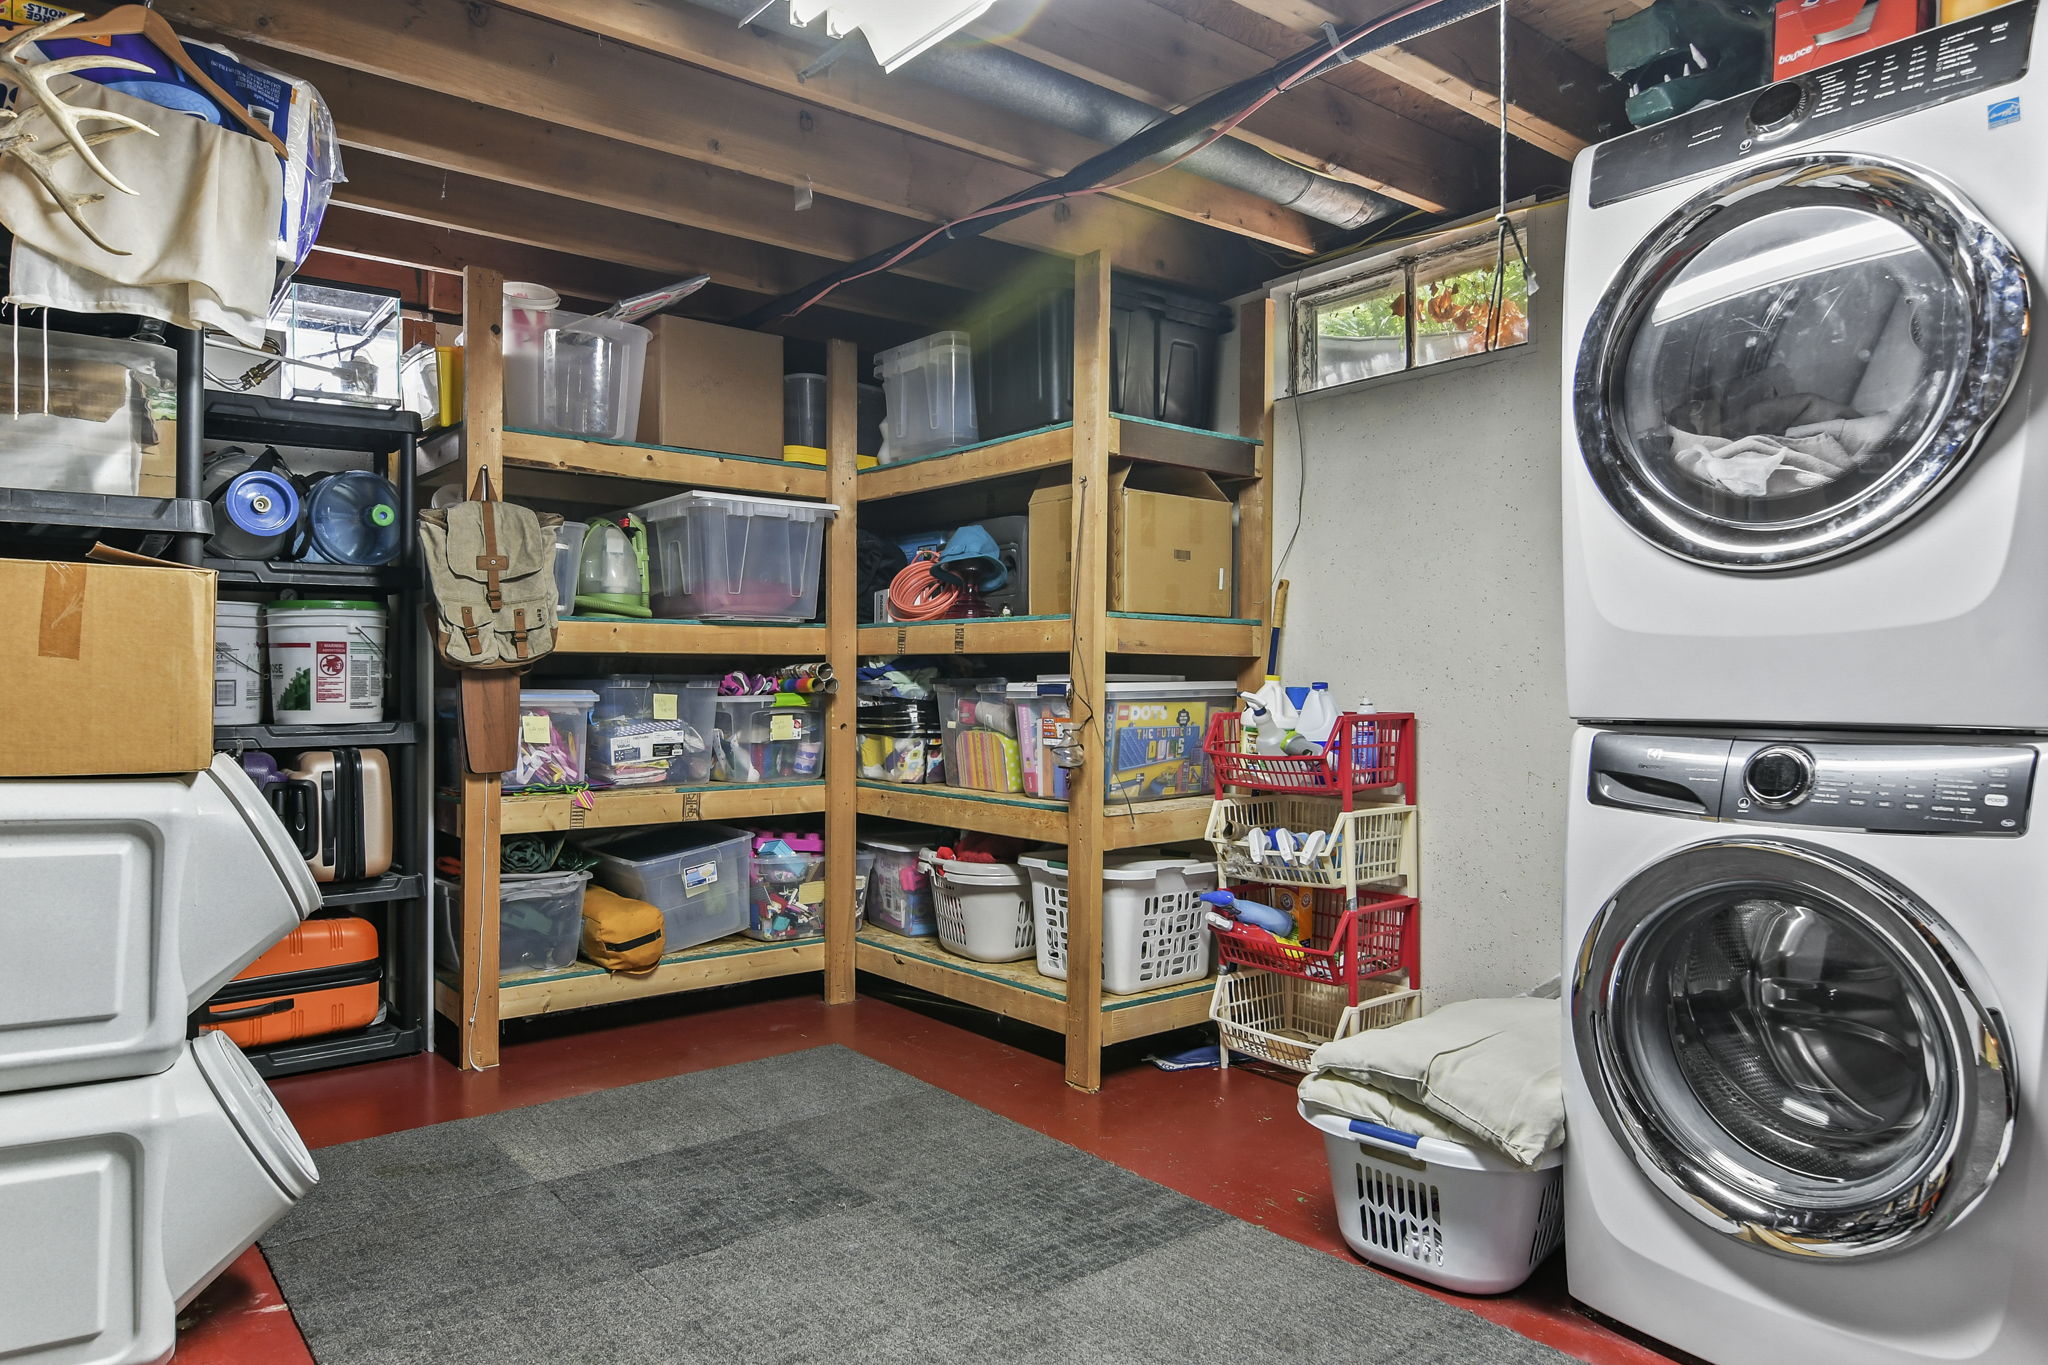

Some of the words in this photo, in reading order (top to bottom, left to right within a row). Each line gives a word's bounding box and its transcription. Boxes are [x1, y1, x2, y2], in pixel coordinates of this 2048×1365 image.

[1778, 45, 1814, 65] bounce
[1130, 704, 1168, 720] DOTS
[1137, 728, 1154, 740] THE
